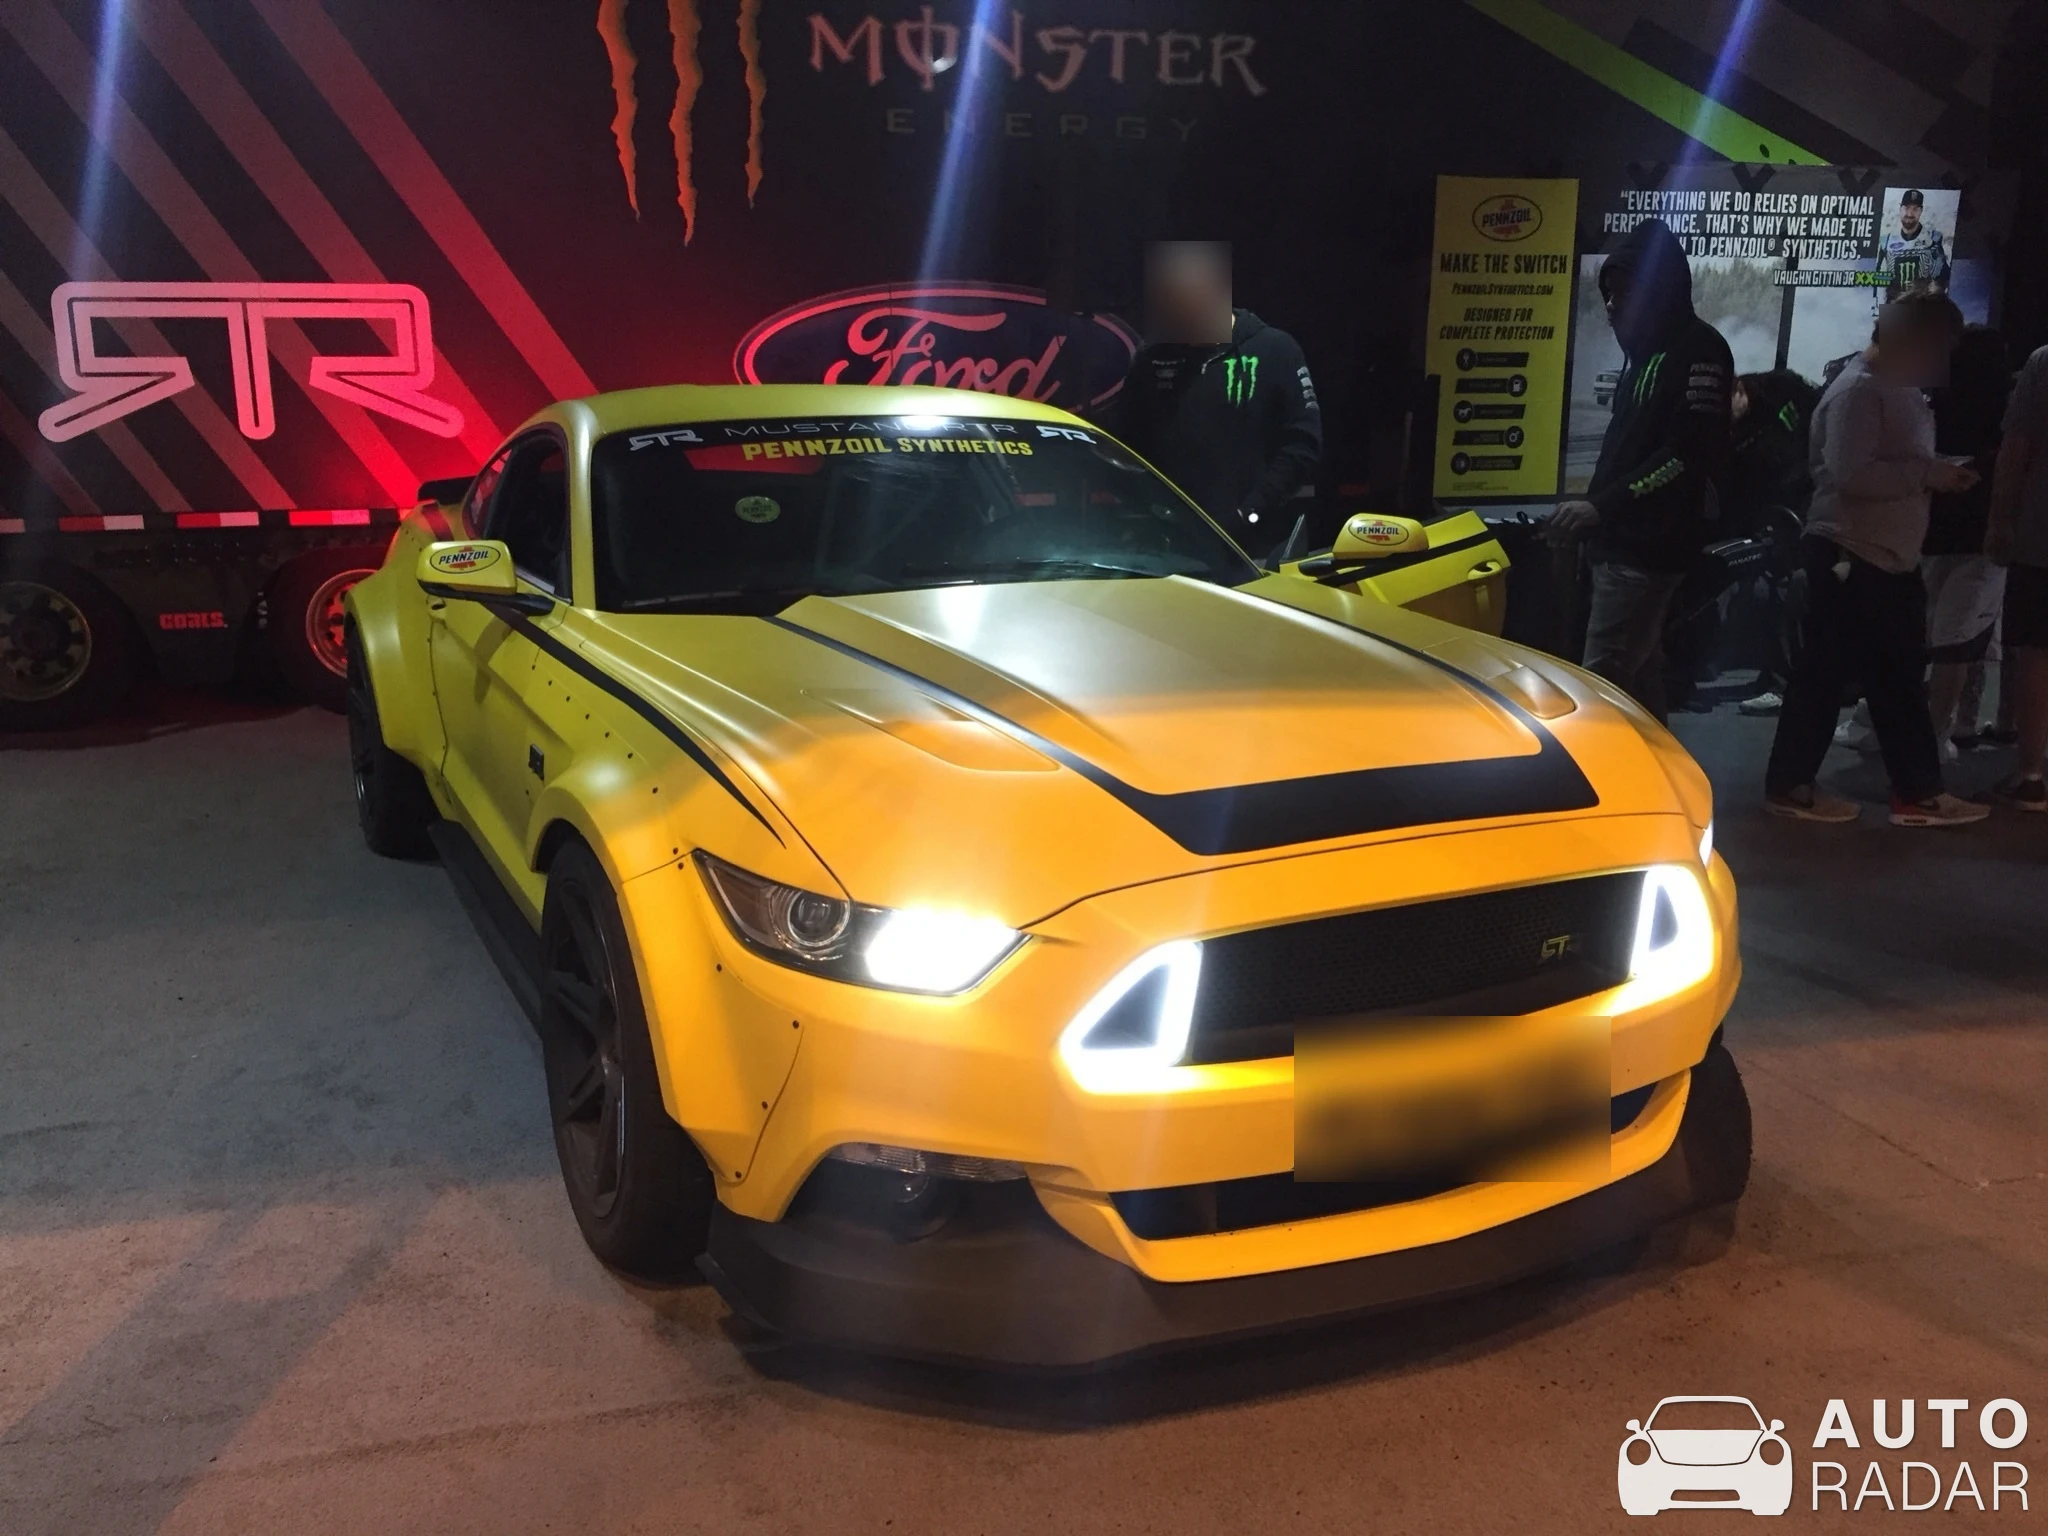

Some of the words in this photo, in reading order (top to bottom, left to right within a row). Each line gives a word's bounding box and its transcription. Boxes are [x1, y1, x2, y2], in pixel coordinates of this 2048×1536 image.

[806, 4, 1267, 97] MONSTER
[1710, 191, 1731, 211] WE
[1734, 192, 1751, 212] DO
[1753, 193, 1798, 213] RELIES
[1800, 195, 1818, 214] ON
[1820, 195, 1875, 216] OPTIMAL
[1482, 208, 1532, 228] PENNZOIL
[1705, 214, 1749, 235] THAT'S
[1753, 215, 1784, 235] WHY
[1786, 216, 1808, 236] WE
[1810, 217, 1848, 238] MADE
[1850, 218, 1874, 238] THE
[1691, 236, 1706, 256] TO
[1440, 253, 1479, 273] MAKE
[1484, 254, 1510, 273] THE
[1514, 254, 1568, 274] SWITCH
[1463, 308, 1511, 322] DESIGNED
[1514, 308, 1534, 322] FOR
[1439, 326, 1492, 340] COMPLETE
[1494, 326, 1555, 340] PROTECTION
[38, 281, 465, 443] RTR
[824, 307, 1067, 402] Ford
[742, 437, 893, 461] PENNZOIL
[899, 437, 1034, 456] SYNTHETICS
[1356, 526, 1400, 536] PENNZOIL
[438, 550, 489, 566] PENNZOIL
